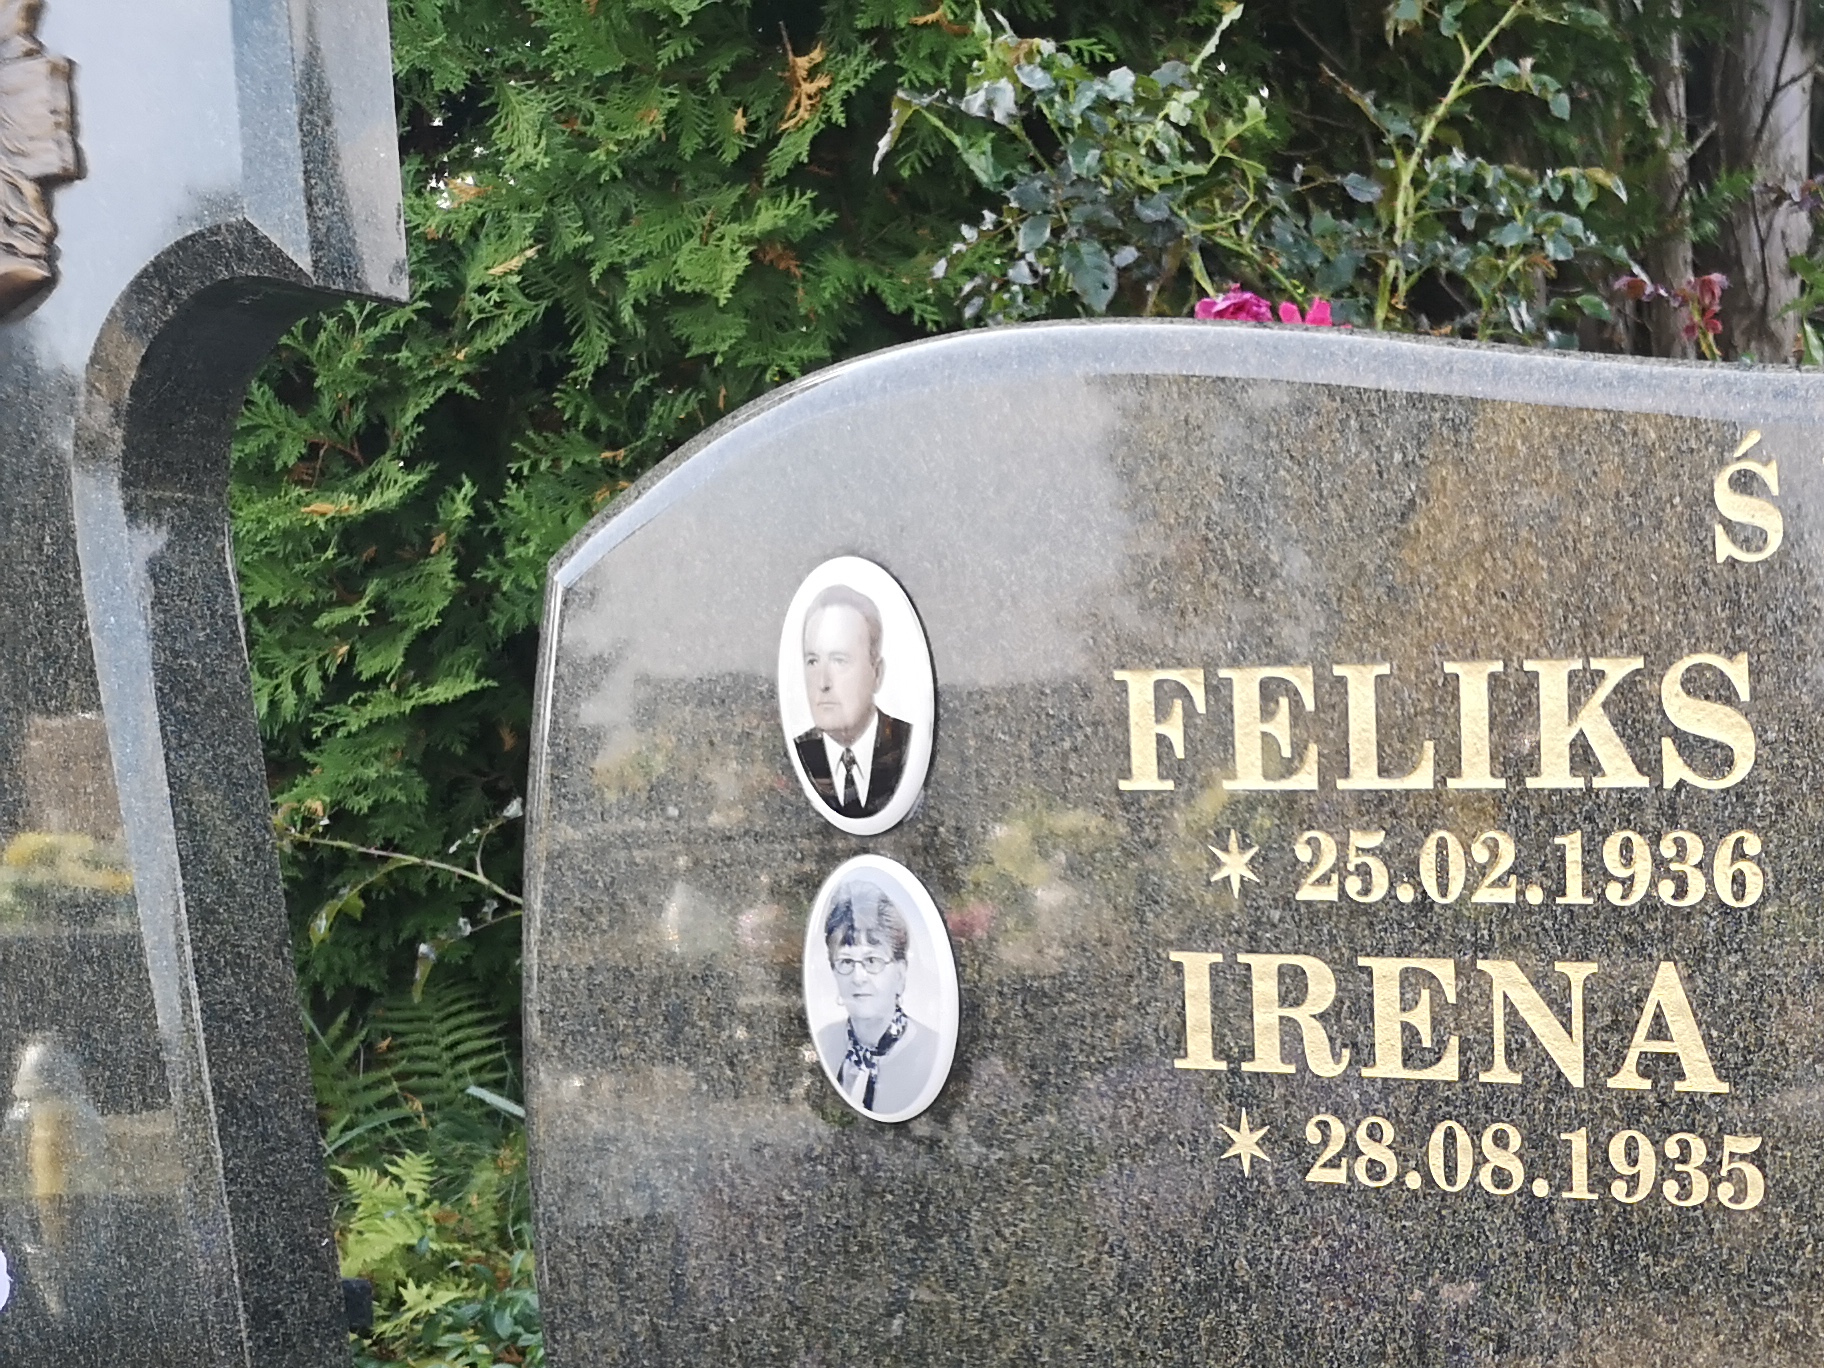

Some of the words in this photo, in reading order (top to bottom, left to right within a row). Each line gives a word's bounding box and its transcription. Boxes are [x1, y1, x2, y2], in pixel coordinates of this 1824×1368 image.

[1113, 651, 1757, 792] FELIKS
[1293, 829, 1765, 909] 25.02.1936
[1168, 950, 1730, 1094] IRENA
[1304, 1113, 1766, 1211] 28.08.1935
